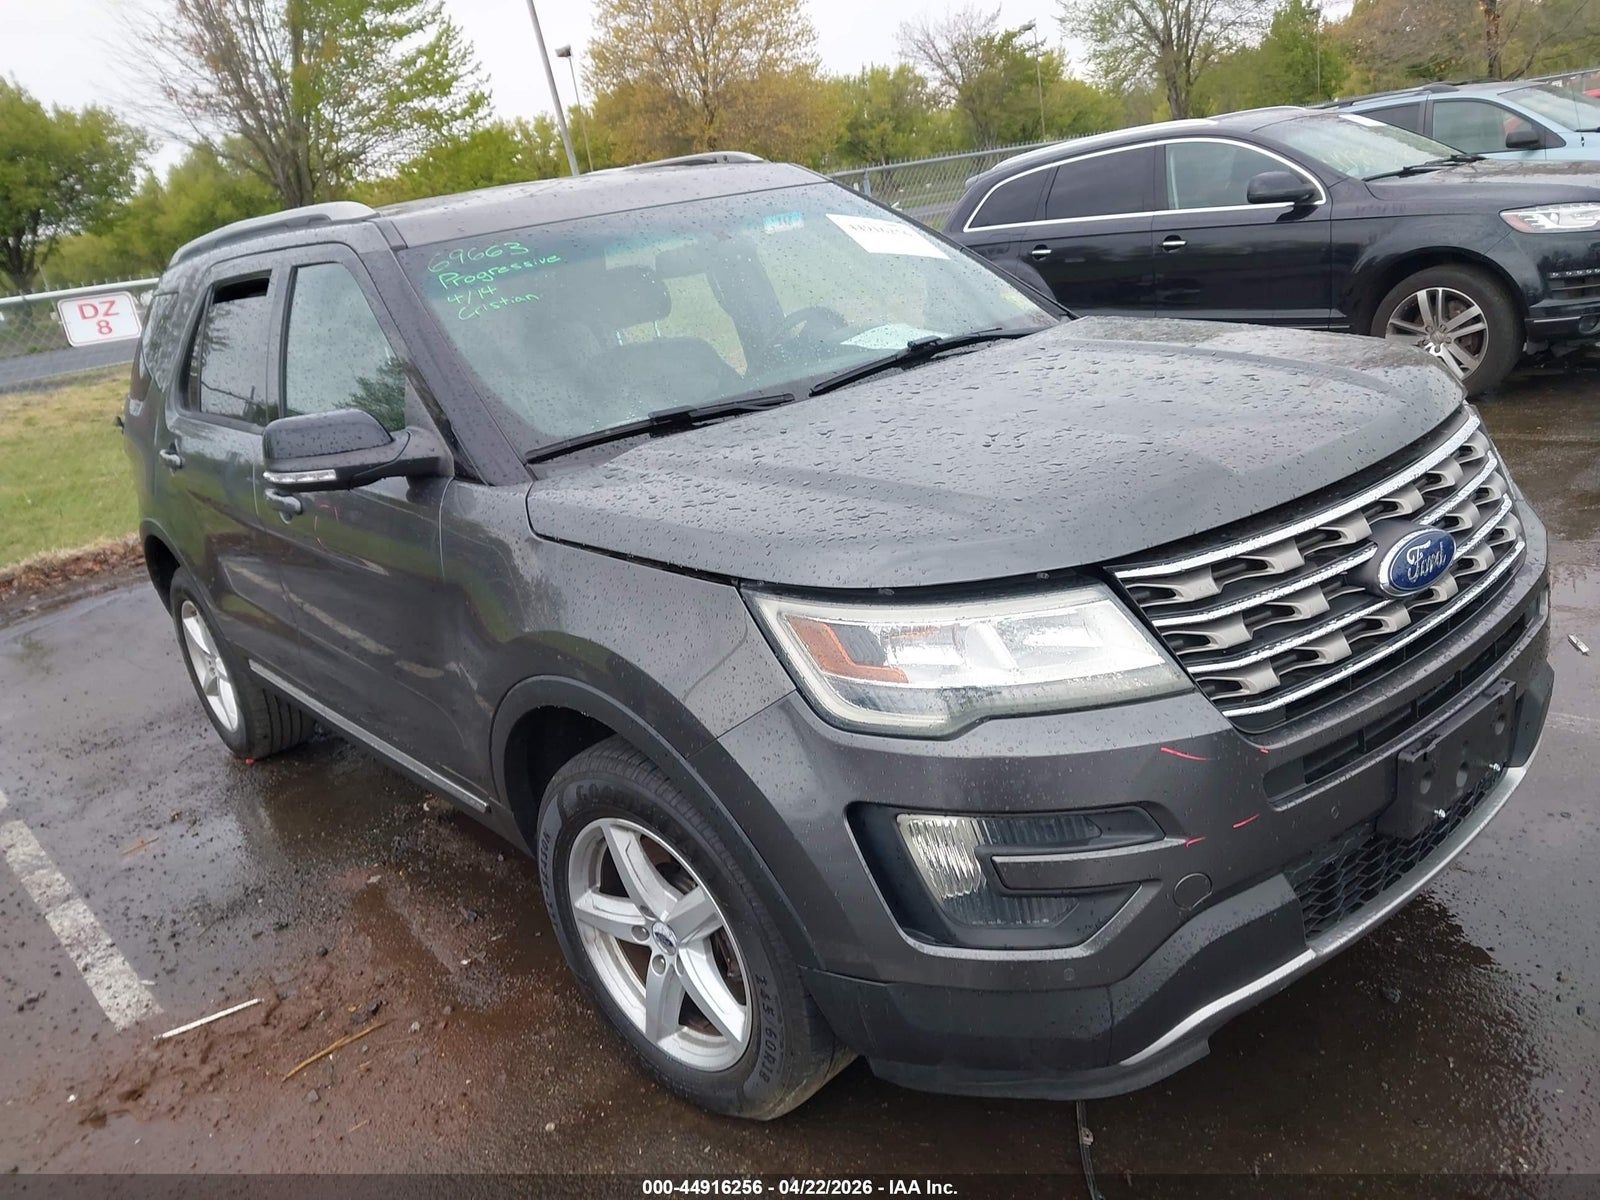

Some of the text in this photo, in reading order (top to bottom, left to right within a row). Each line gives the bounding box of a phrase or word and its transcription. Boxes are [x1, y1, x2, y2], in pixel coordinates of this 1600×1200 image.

[428, 242, 529, 272] 69663
[438, 255, 561, 289] Progressive
[447, 285, 497, 305] 4/14
[458, 293, 540, 320] Cristian
[78, 300, 120, 320] DZ
[97, 320, 113, 335] 8
[1406, 540, 1447, 583] Ford
